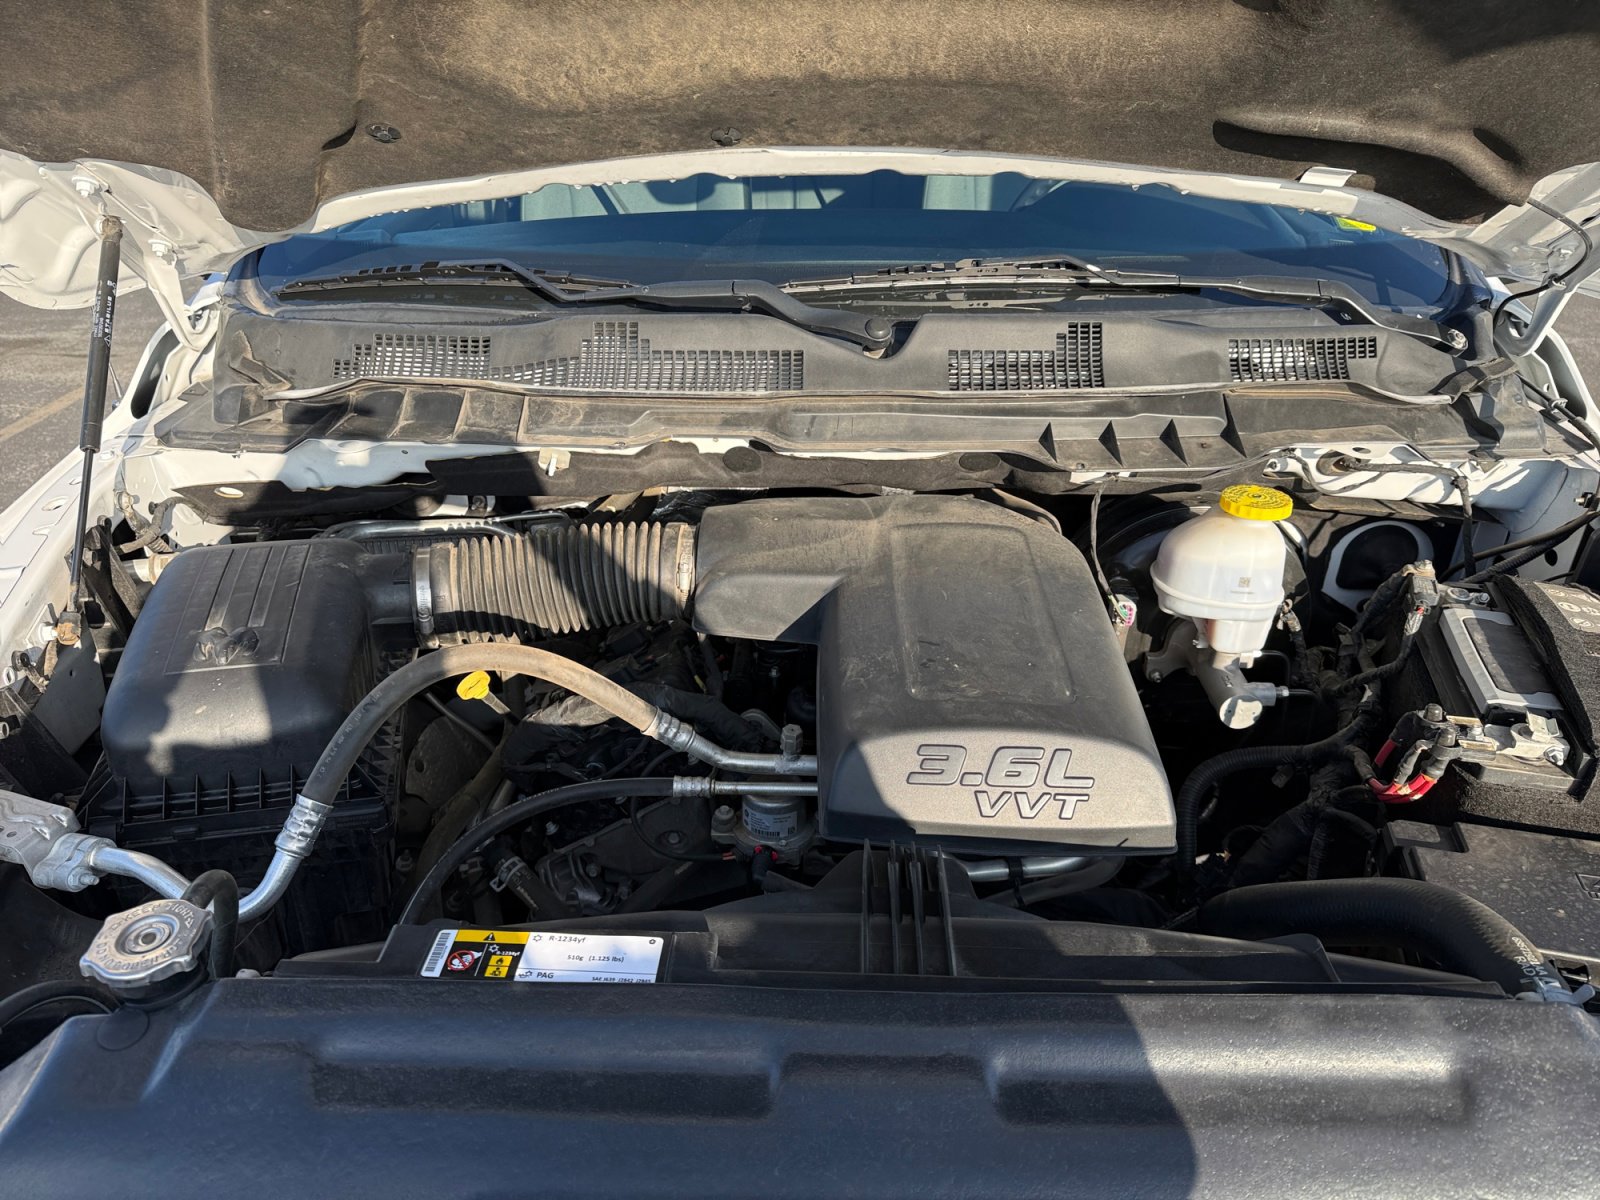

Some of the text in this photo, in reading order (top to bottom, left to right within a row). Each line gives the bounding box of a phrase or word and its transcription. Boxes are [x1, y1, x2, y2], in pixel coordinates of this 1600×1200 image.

[104, 295, 113, 333] STABILUS
[906, 743, 1096, 789] 3.6L
[973, 790, 1090, 820] VVT
[123, 902, 194, 921] KEEP TIGHT
[548, 935, 587, 944] R-1234yf
[567, 954, 584, 962] 510g
[1514, 955, 1536, 976] RAD
[536, 971, 555, 979] PAG
